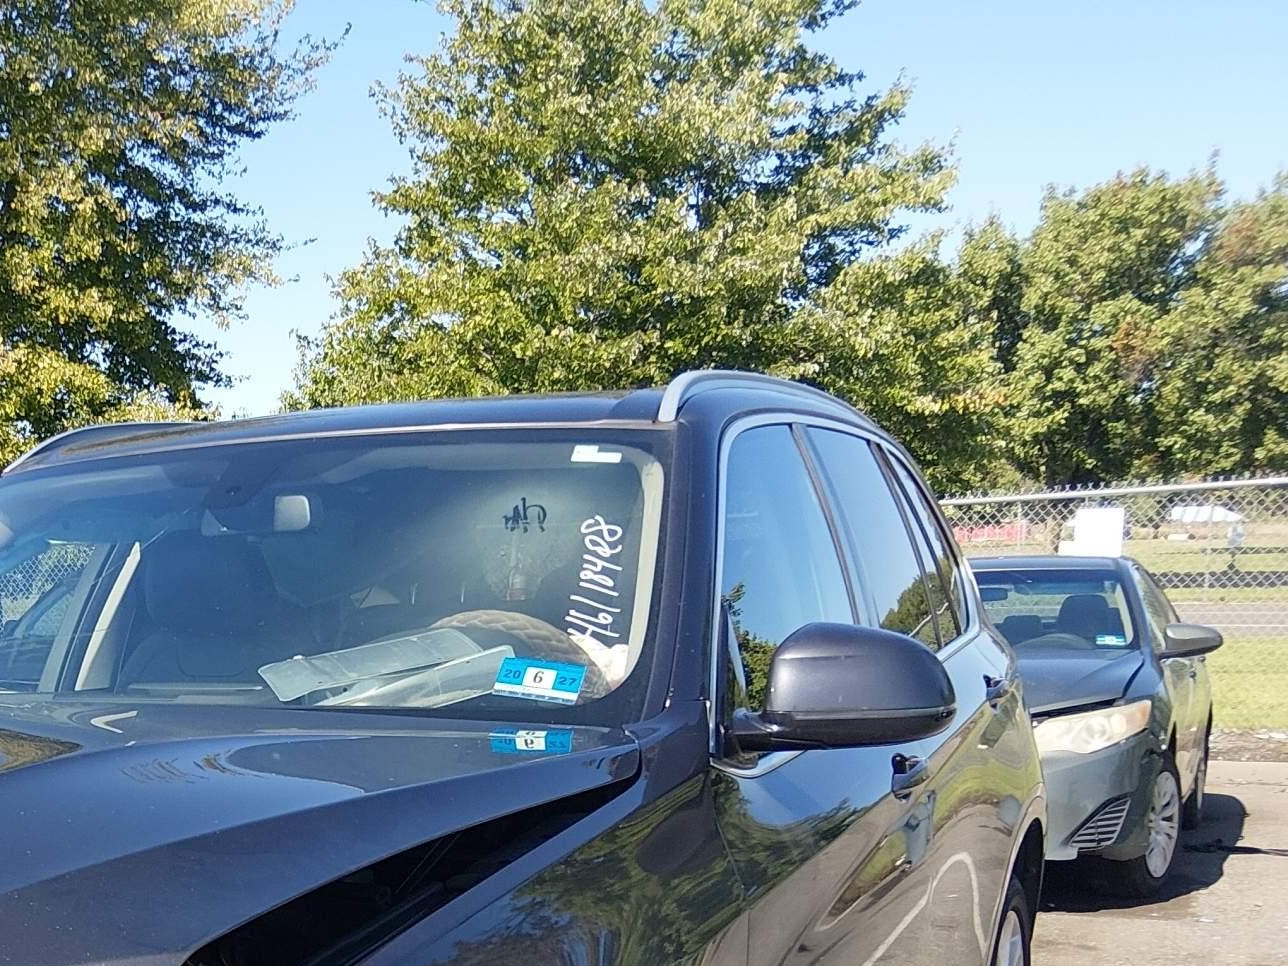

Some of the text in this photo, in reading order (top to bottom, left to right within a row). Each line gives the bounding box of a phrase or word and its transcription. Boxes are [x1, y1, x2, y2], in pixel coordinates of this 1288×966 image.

[503, 669, 577, 687] 20 6 27
